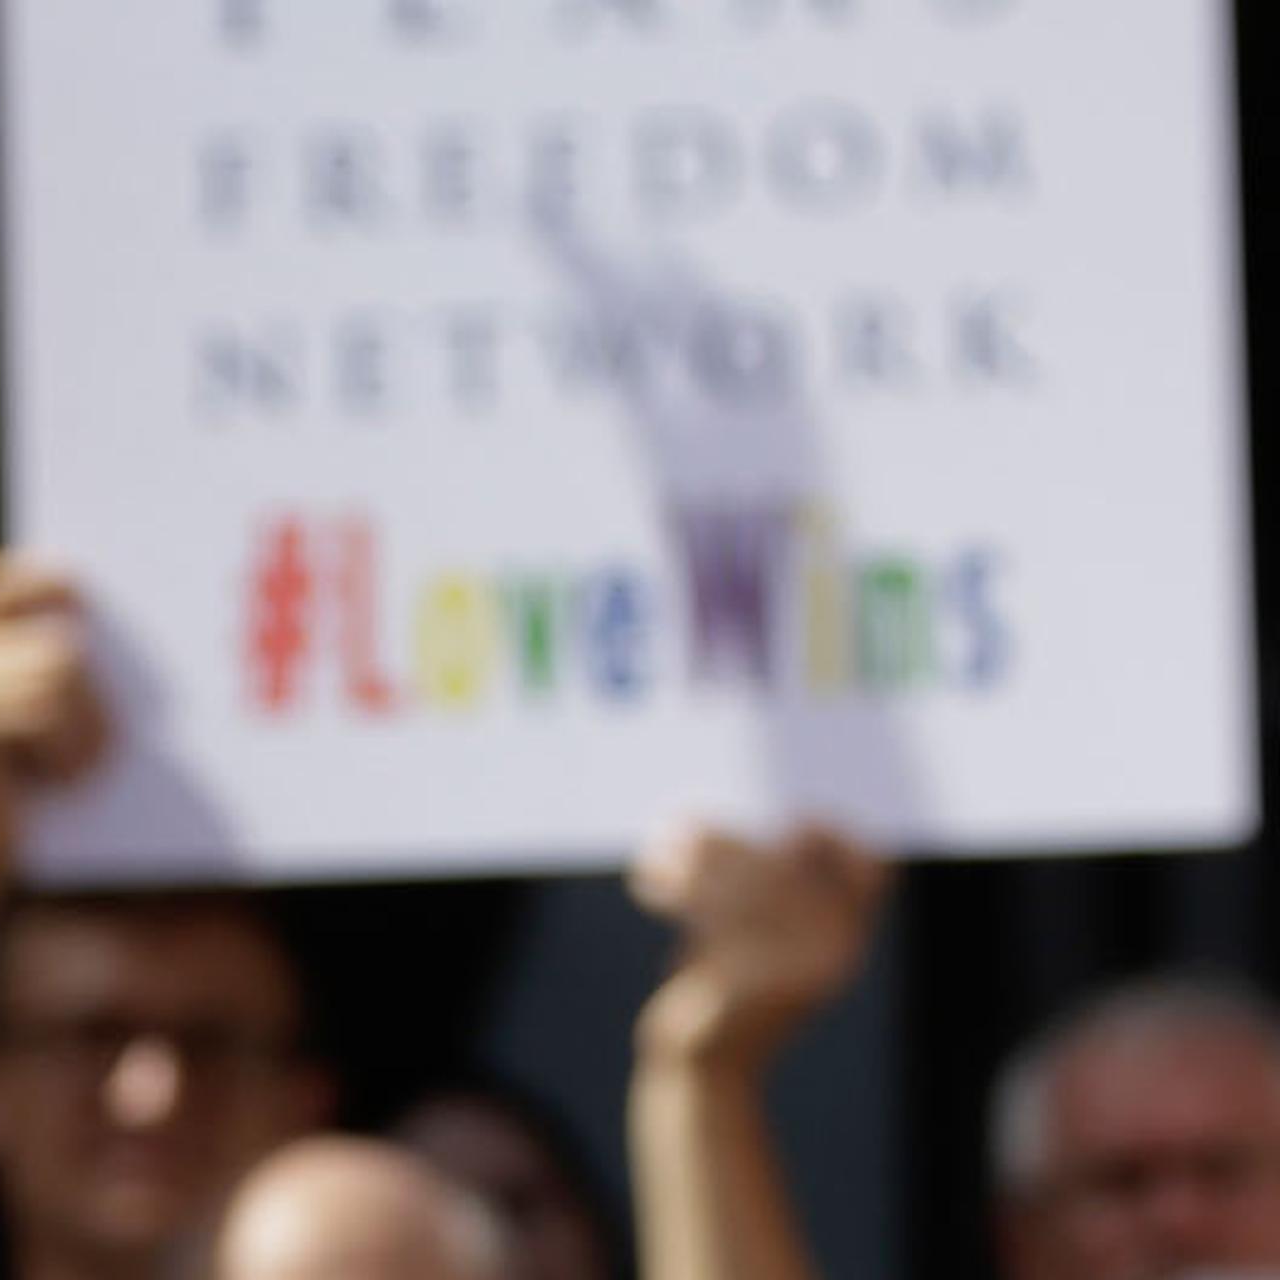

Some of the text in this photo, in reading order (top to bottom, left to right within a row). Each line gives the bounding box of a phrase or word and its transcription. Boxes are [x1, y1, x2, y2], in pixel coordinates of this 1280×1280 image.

[200, 104, 1030, 232] FREEDOM
[195, 288, 1032, 418] NETWORK
[246, 496, 1018, 716] #LoveWins
